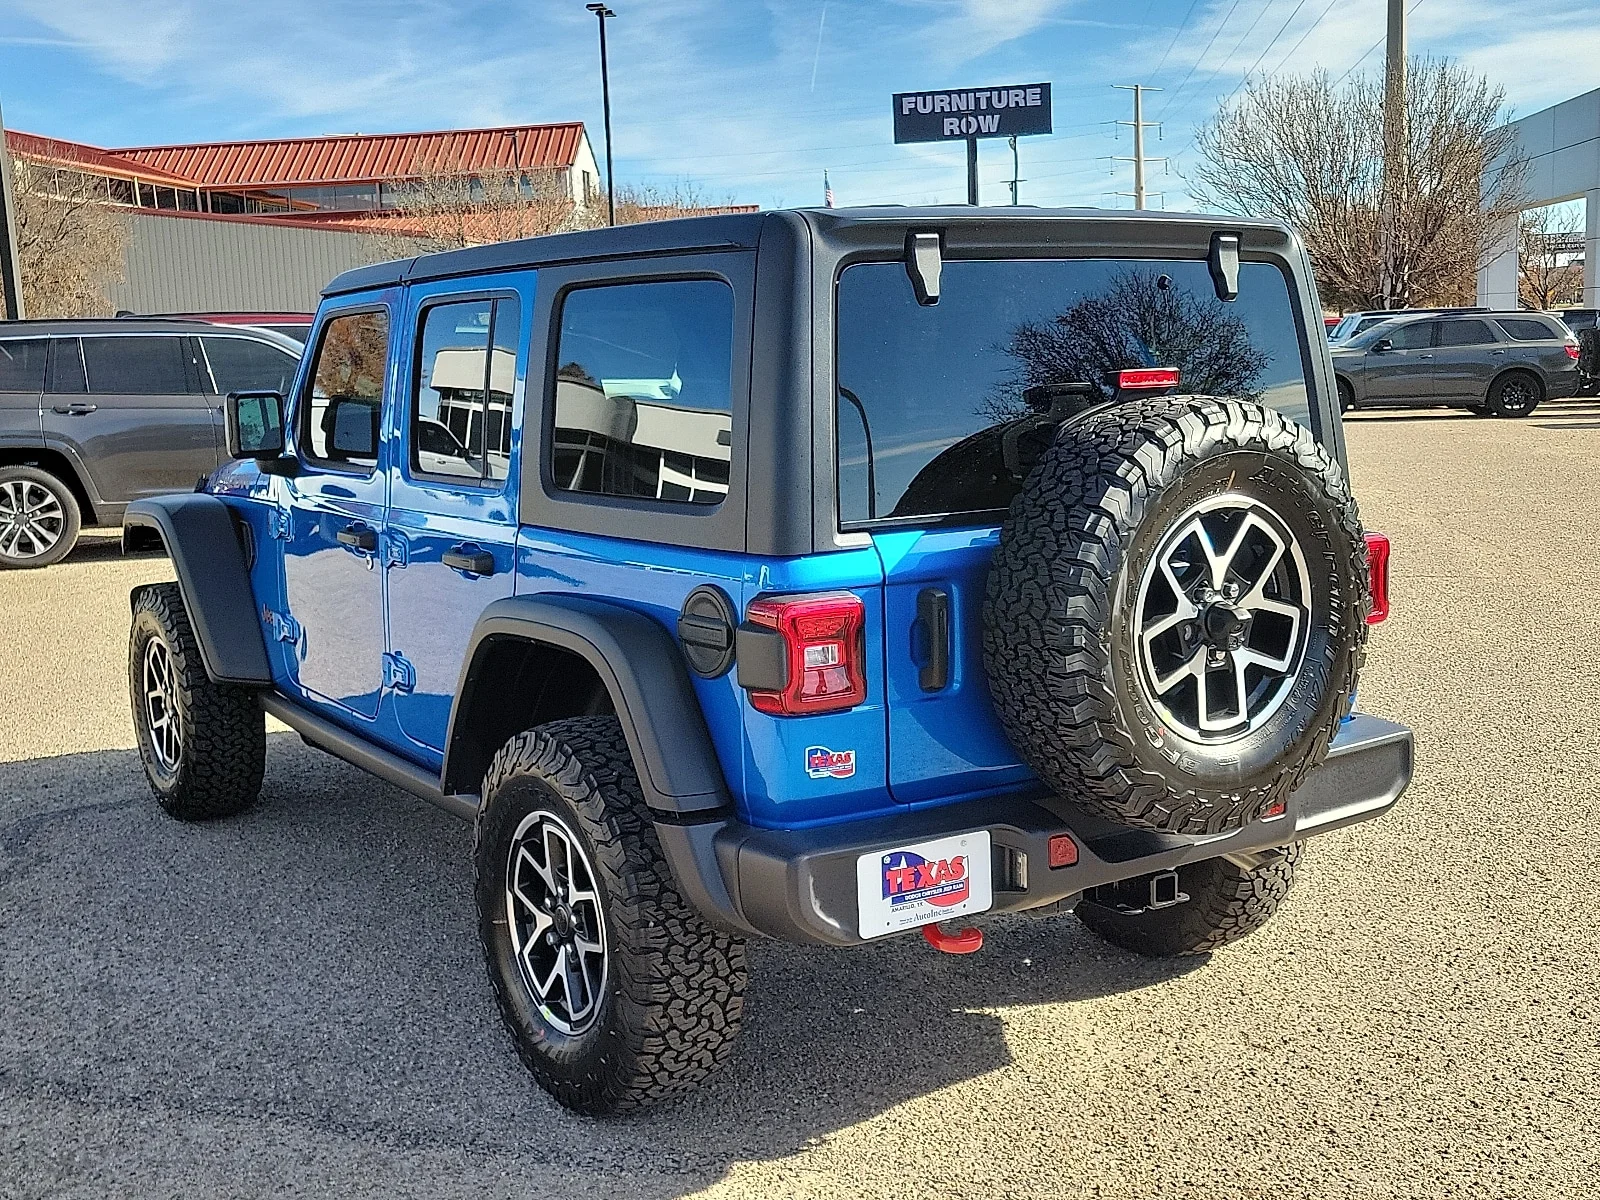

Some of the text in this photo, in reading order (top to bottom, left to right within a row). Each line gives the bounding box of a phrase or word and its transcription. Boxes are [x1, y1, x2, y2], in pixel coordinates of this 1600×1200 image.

[902, 88, 1042, 115] FURNITURE
[943, 114, 1001, 136] ROW
[810, 752, 852, 767] TEXAS
[885, 855, 966, 894] TEXAS
